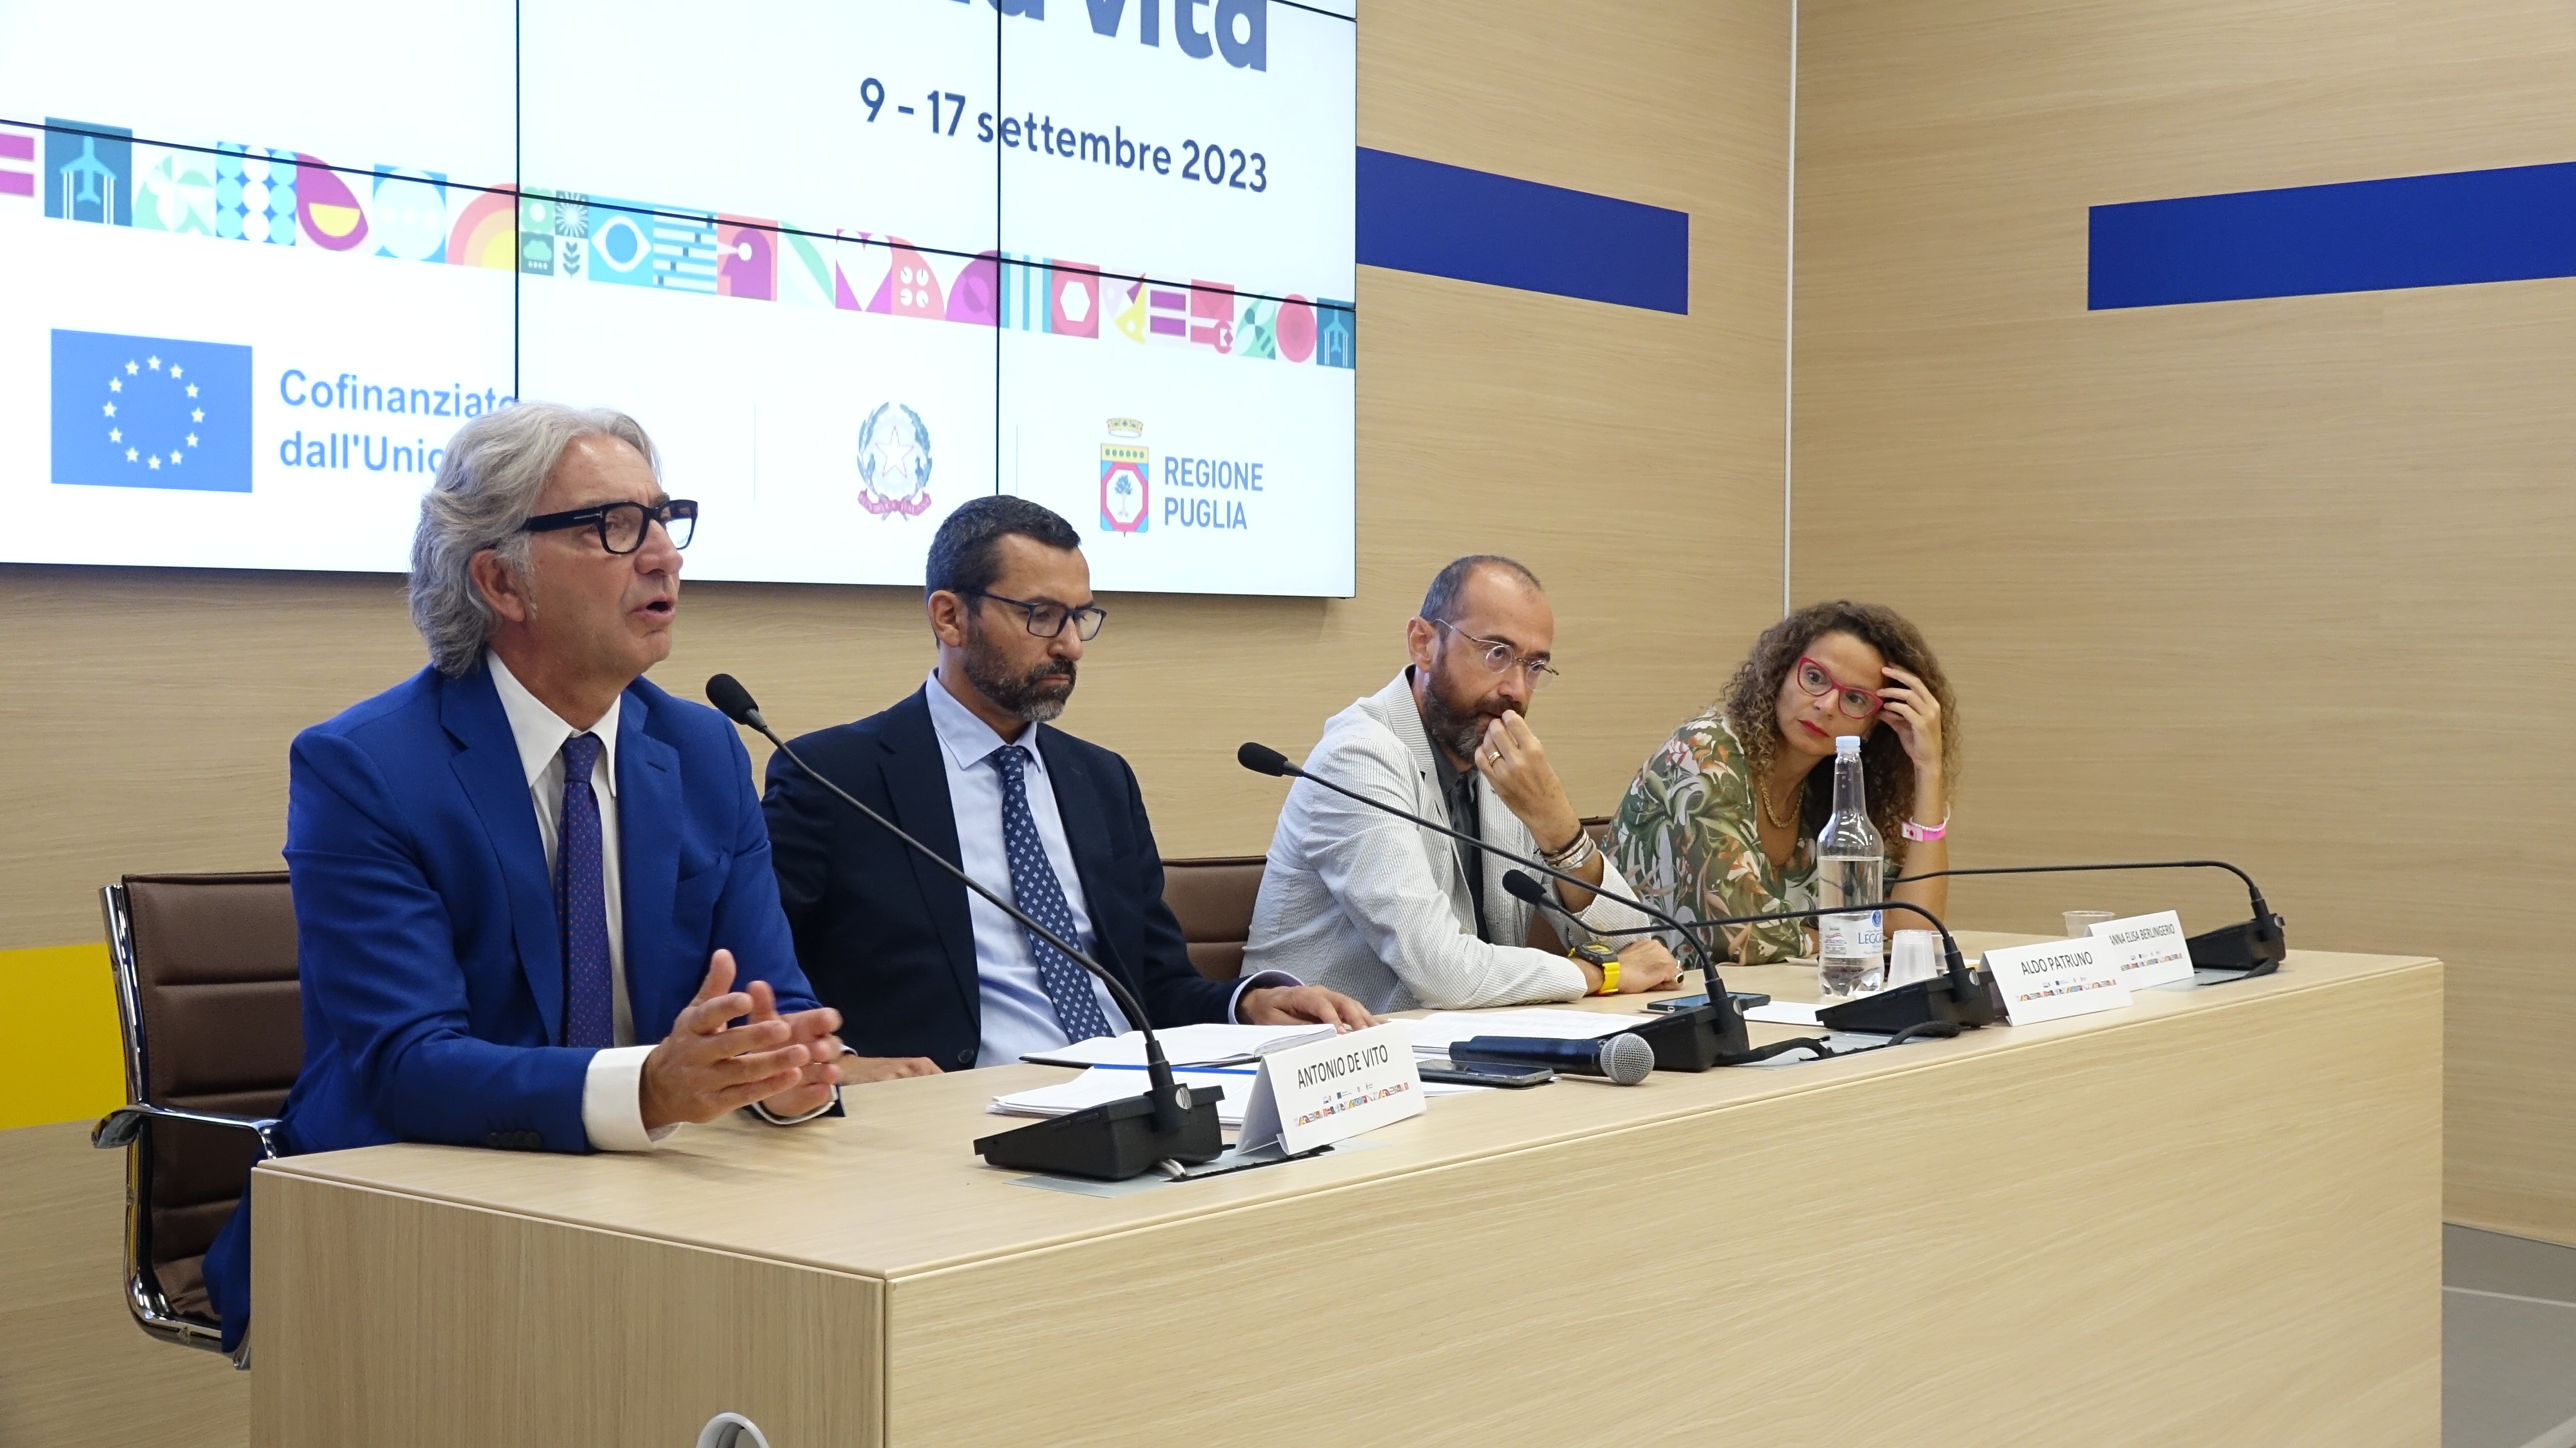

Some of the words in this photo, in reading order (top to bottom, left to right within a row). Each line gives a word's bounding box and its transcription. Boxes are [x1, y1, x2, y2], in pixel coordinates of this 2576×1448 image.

[860, 77, 885, 123] 9
[898, 105, 914, 115] -
[927, 90, 966, 136] 17
[977, 112, 1171, 175] settembre
[1182, 139, 1267, 193] 2023
[1164, 456, 1263, 492] REGIONE
[1164, 497, 1247, 530] PUGLIA
[2125, 930, 2140, 943] ELISA
[2021, 957, 2048, 975] ALDO
[2049, 951, 2093, 971] PATRUNO
[1298, 1057, 1345, 1089] ANTONIO
[1347, 1052, 1362, 1073] DE
[1362, 1044, 1388, 1068] VITO
